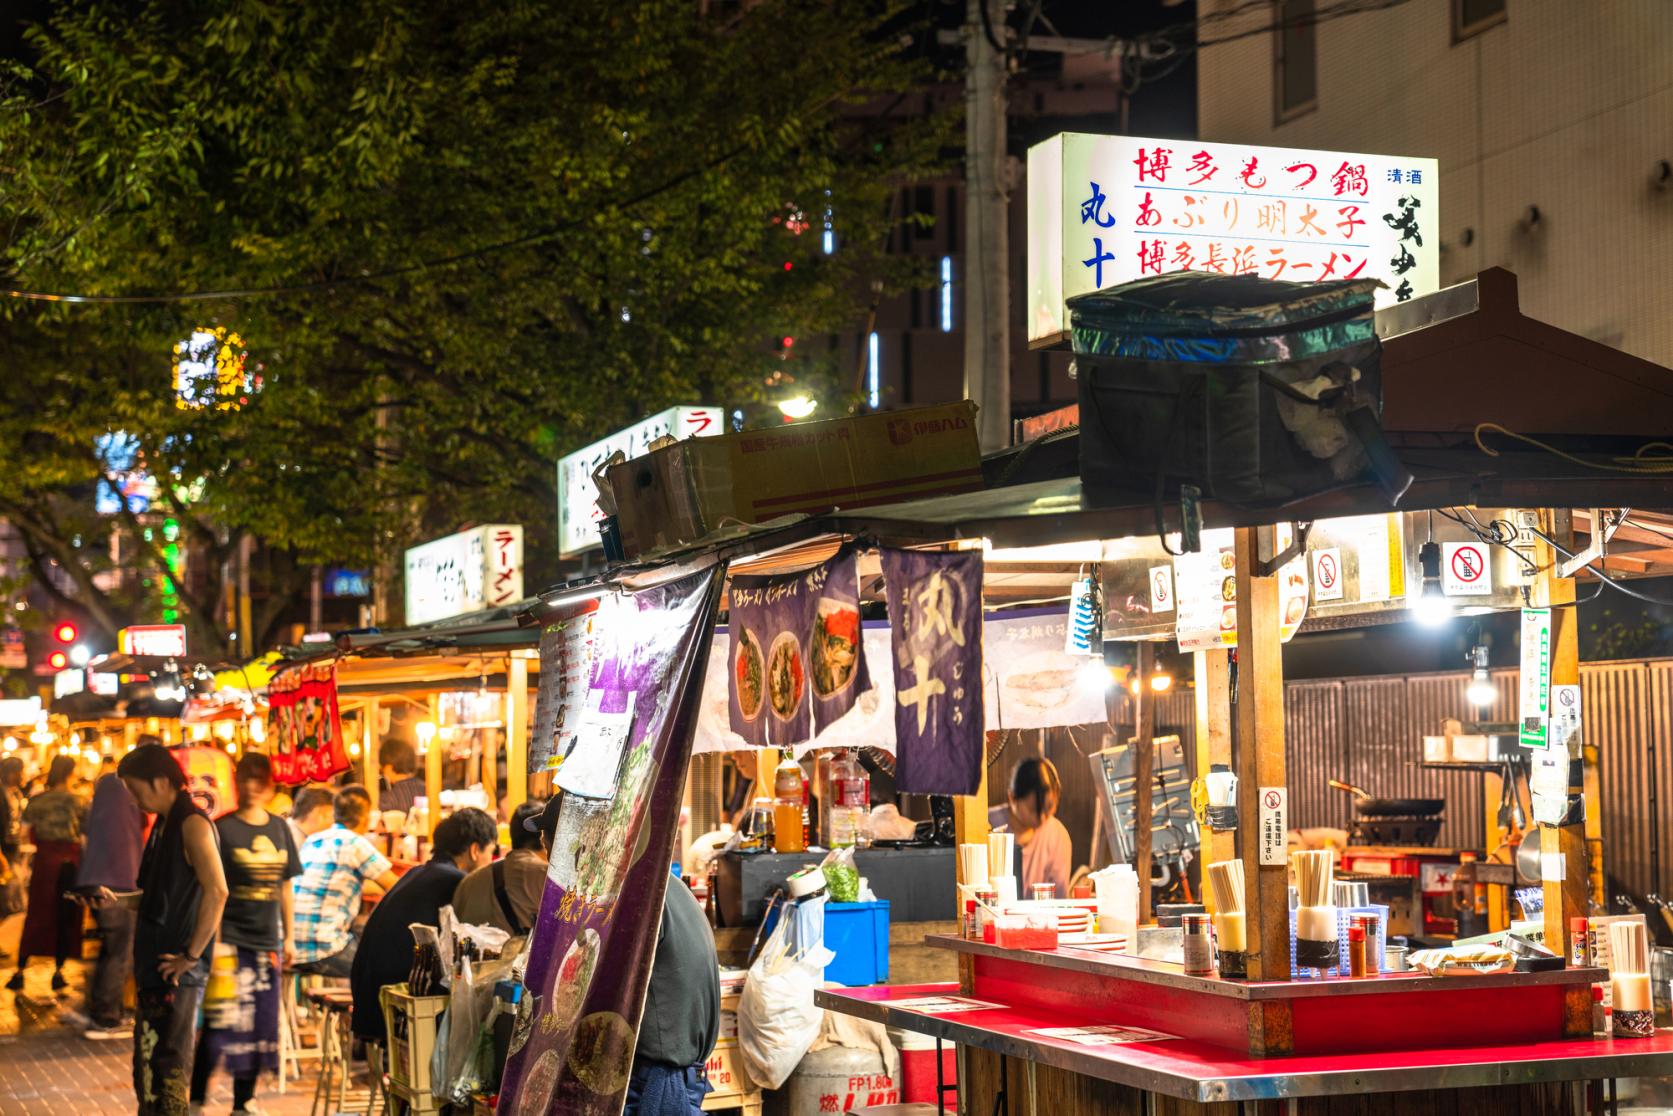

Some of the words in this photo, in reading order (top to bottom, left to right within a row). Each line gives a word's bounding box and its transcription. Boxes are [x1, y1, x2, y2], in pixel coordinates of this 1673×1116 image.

[1133, 147, 1369, 197] 博多もつ鍋
[1387, 168, 1422, 184] 清酒
[1080, 182, 1116, 289] 丸十
[1135, 192, 1366, 240] あぶり明太子
[1137, 239, 1368, 282] 博多長浜ラーメン
[686, 411, 712, 433] ラ
[494, 530, 515, 603] ラーメン
[897, 567, 967, 737] 丸十
